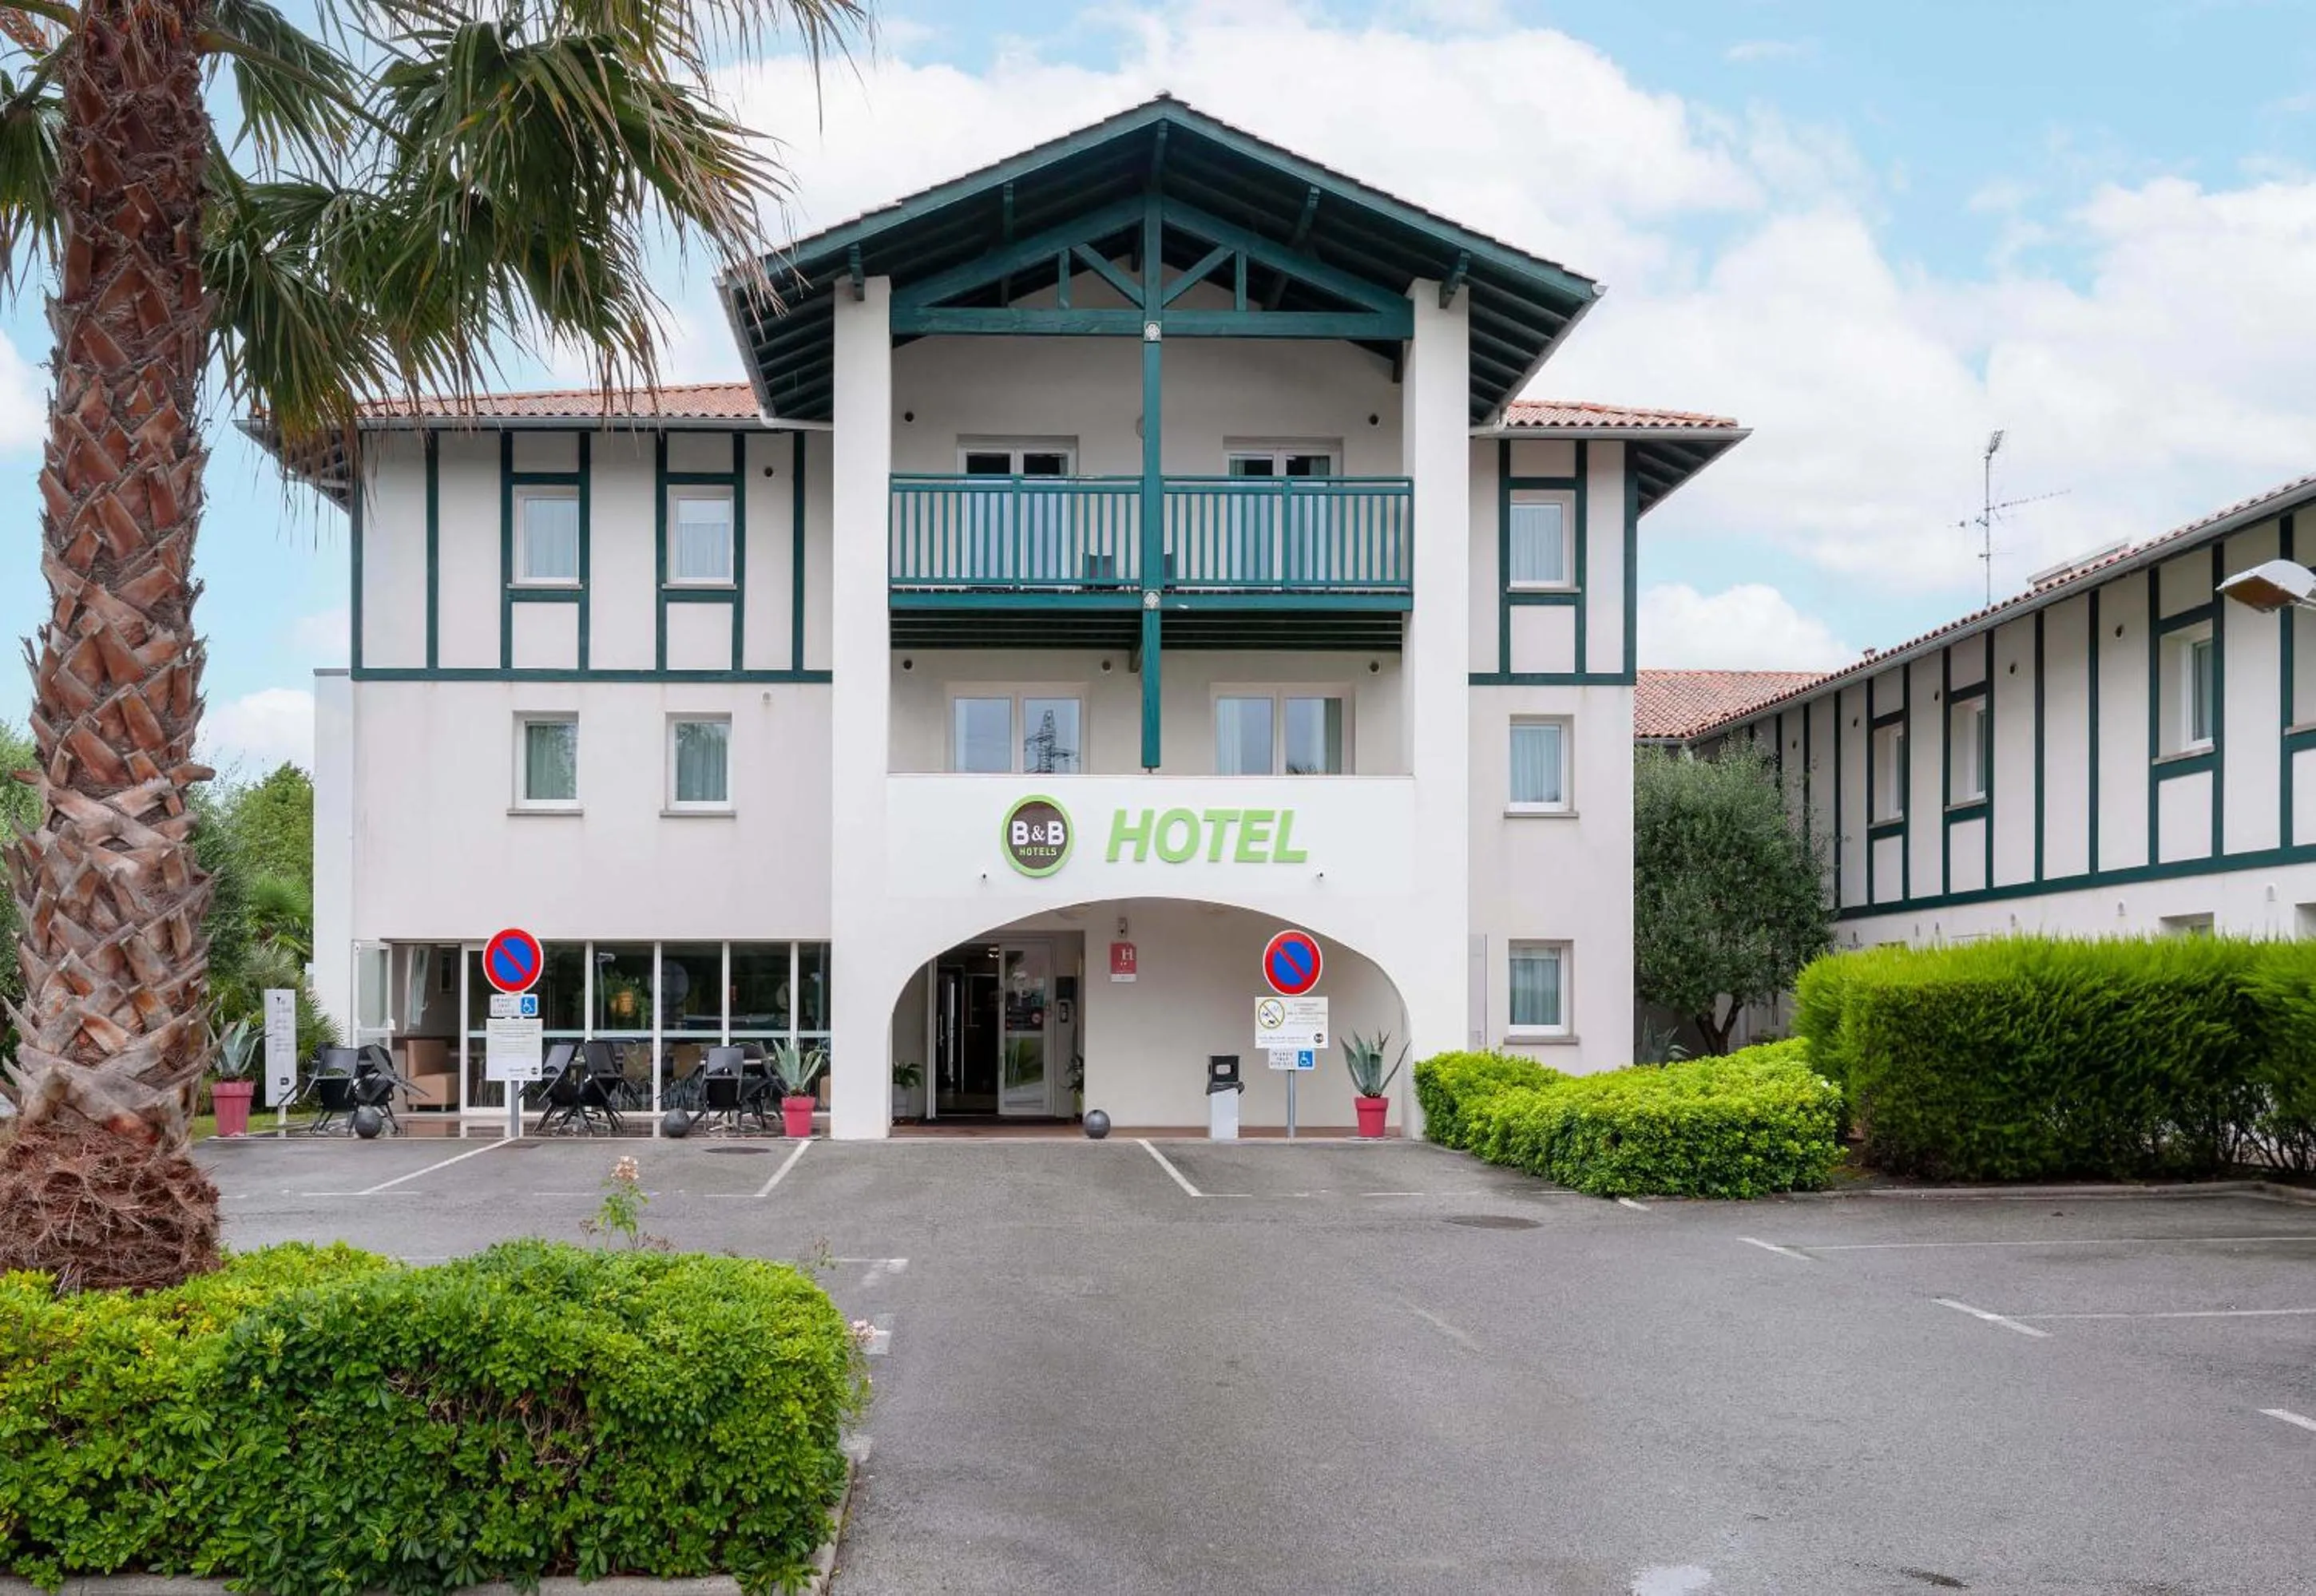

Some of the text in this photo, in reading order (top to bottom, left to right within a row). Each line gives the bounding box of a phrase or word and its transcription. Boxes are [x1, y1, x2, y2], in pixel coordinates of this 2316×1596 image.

[1012, 821, 1065, 845] B&B
[1105, 808, 1308, 864] HOTEL
[1018, 847, 1057, 856] HOTELS
[1121, 948, 1134, 960] H
